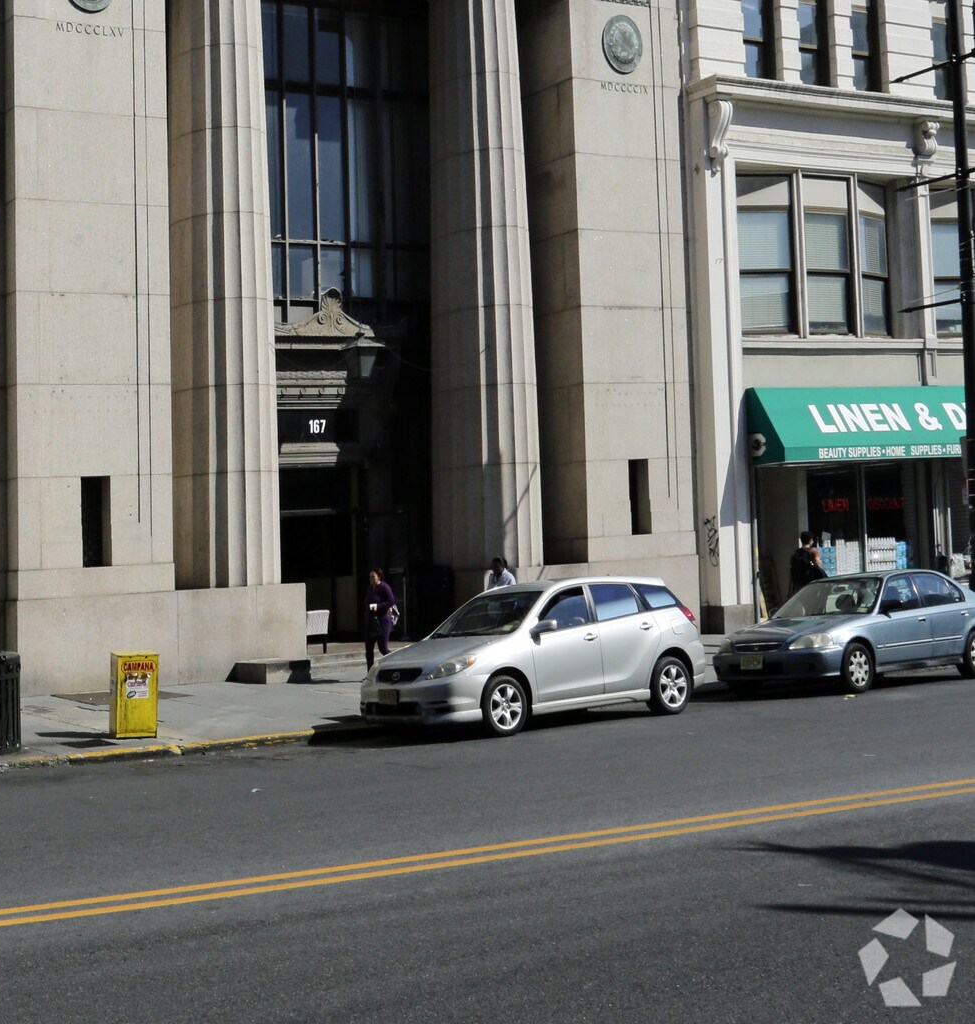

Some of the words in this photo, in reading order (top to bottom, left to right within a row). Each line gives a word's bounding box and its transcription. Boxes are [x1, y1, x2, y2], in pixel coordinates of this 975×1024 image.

[56, 22, 124, 37] MDCCCLXV
[600, 81, 648, 94] MDCCCCIX
[808, 403, 912, 433] LINEN
[914, 402, 943, 430] &
[941, 402, 967, 431] D
[308, 419, 326, 433] 167
[818, 448, 847, 459] BEAUTY
[848, 446, 881, 458] SUPPLIES
[910, 444, 942, 455] SUPPLIES
[123, 662, 154, 672] CAMPANA
